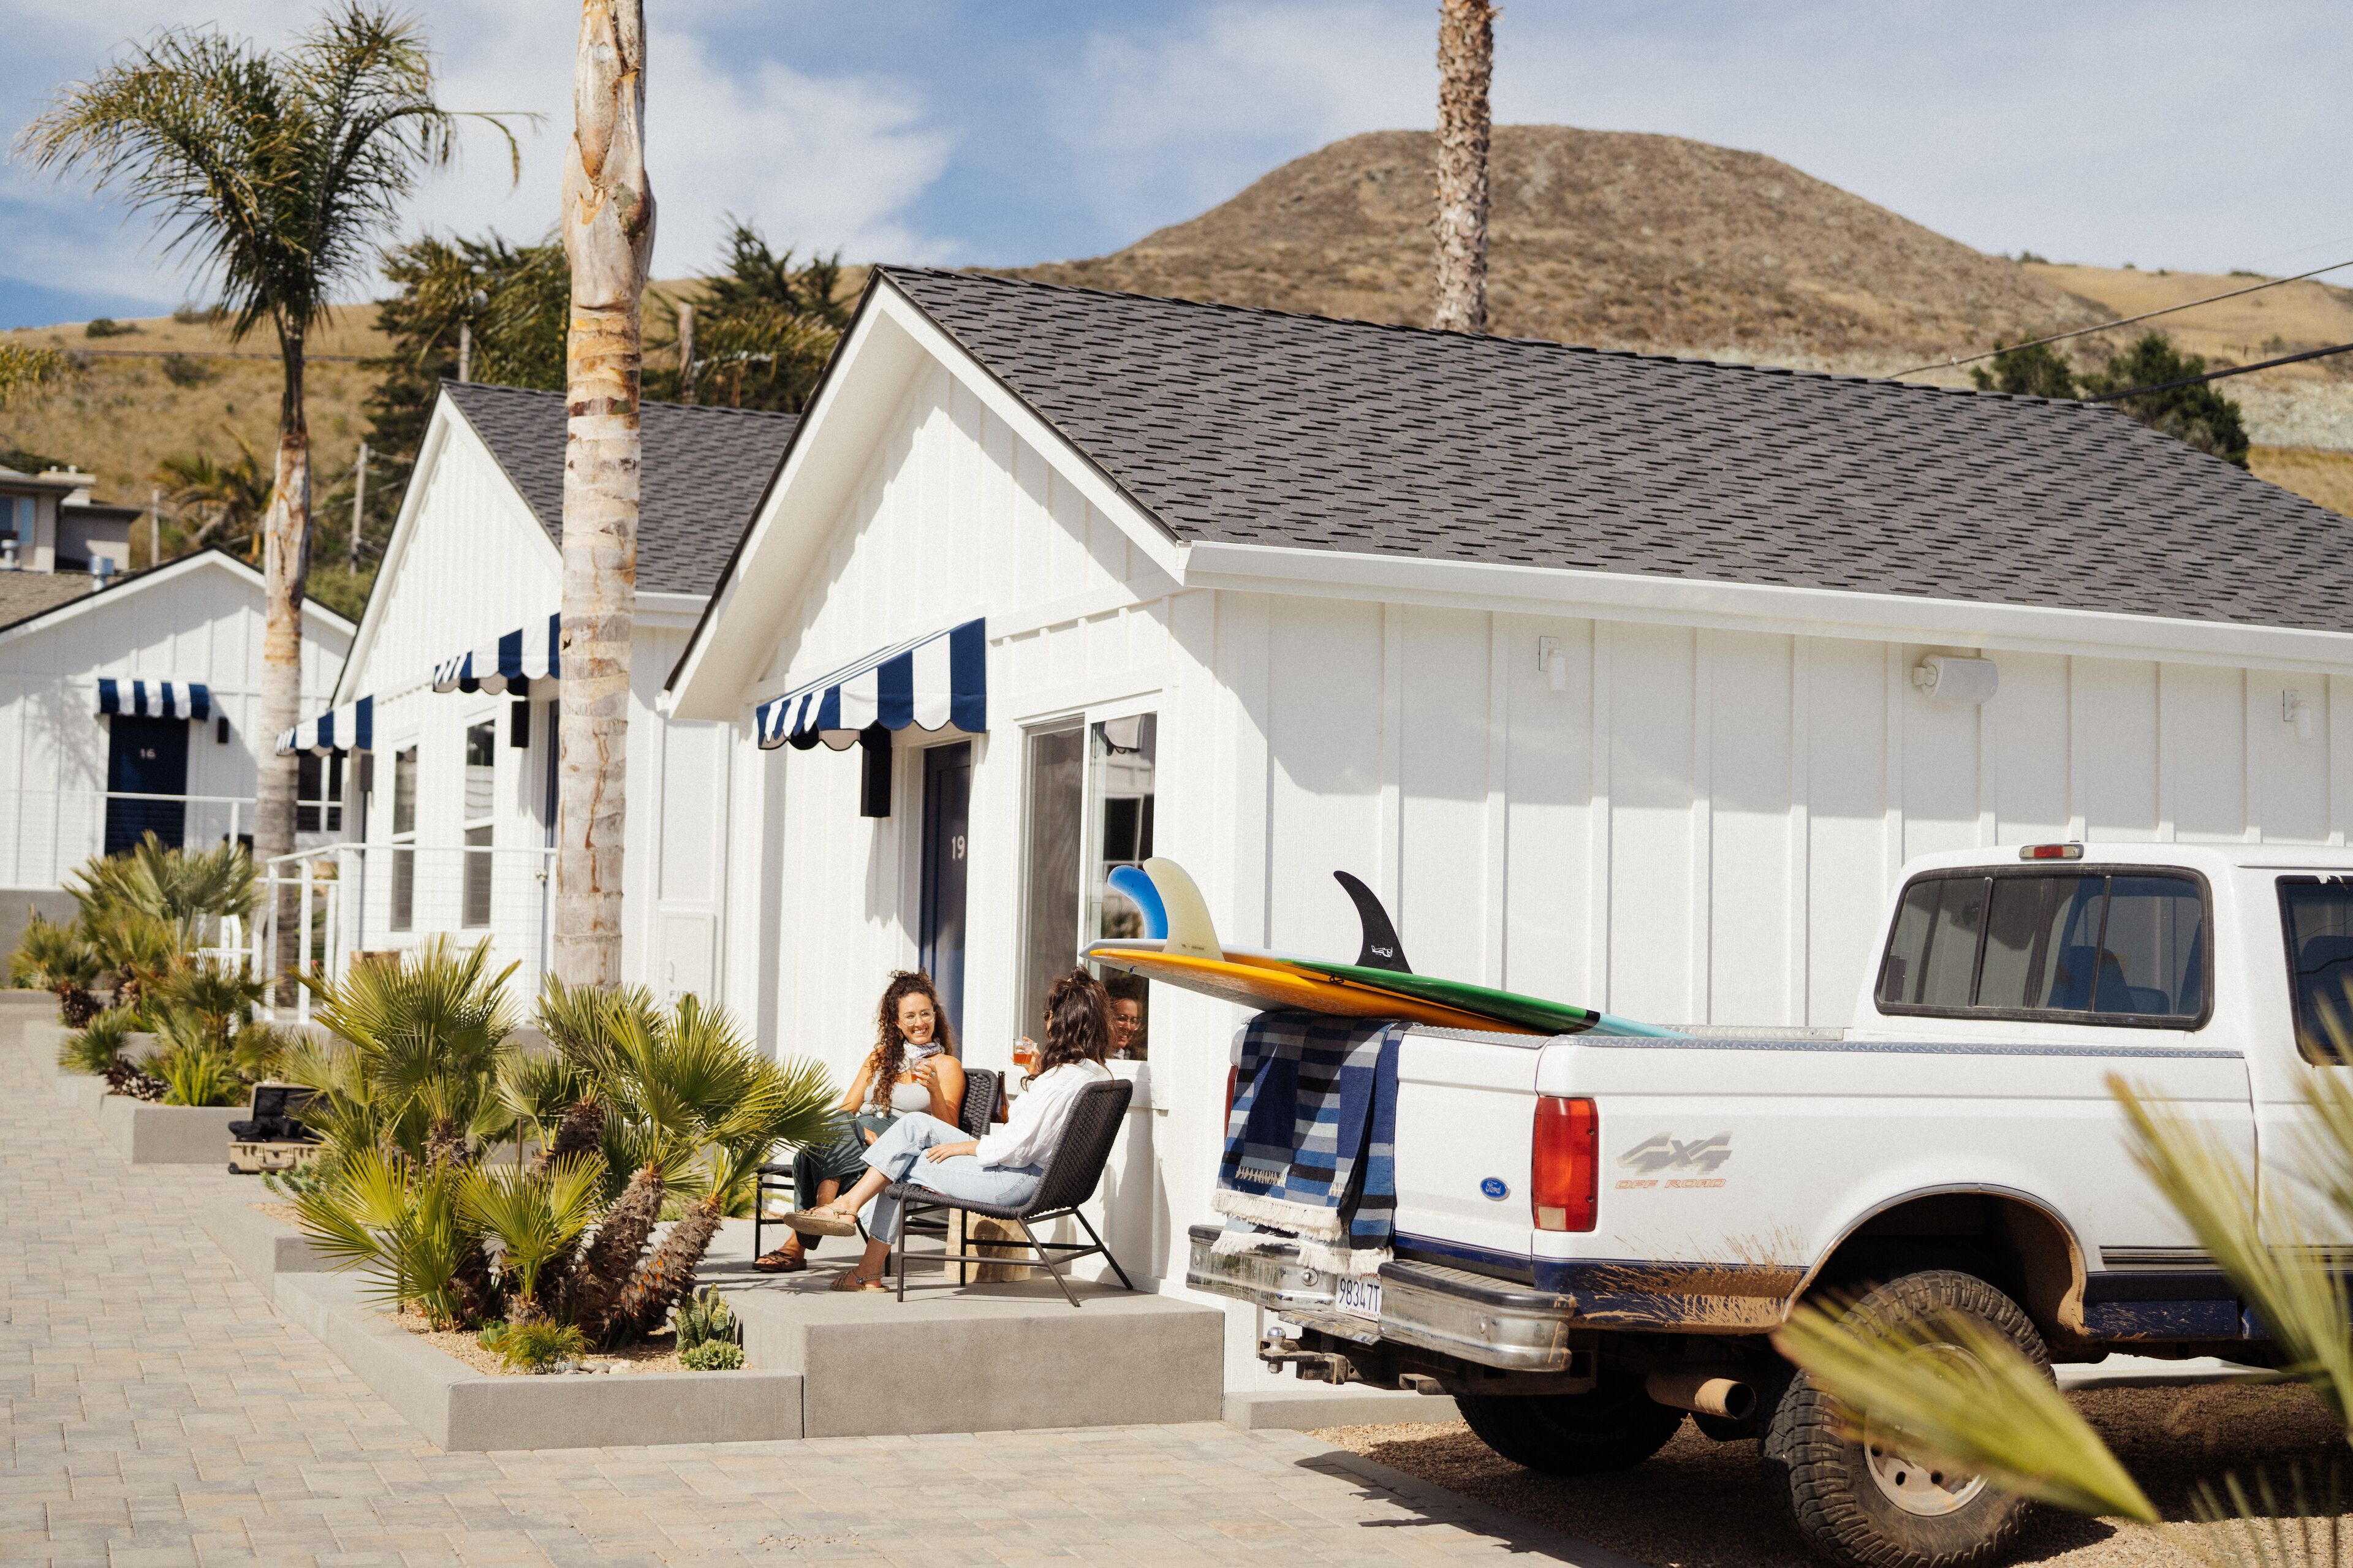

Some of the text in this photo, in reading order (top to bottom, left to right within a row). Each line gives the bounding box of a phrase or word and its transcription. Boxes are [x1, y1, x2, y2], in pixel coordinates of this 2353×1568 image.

[140, 748, 157, 760] 16
[952, 835, 966, 861] 19
[1485, 1180, 1502, 1194] Ford
[1615, 1178, 1726, 1189] OFF ROAD
[1339, 1278, 1380, 1312] 98347T
[1349, 1308, 1376, 1318] dmv.ca.gov
